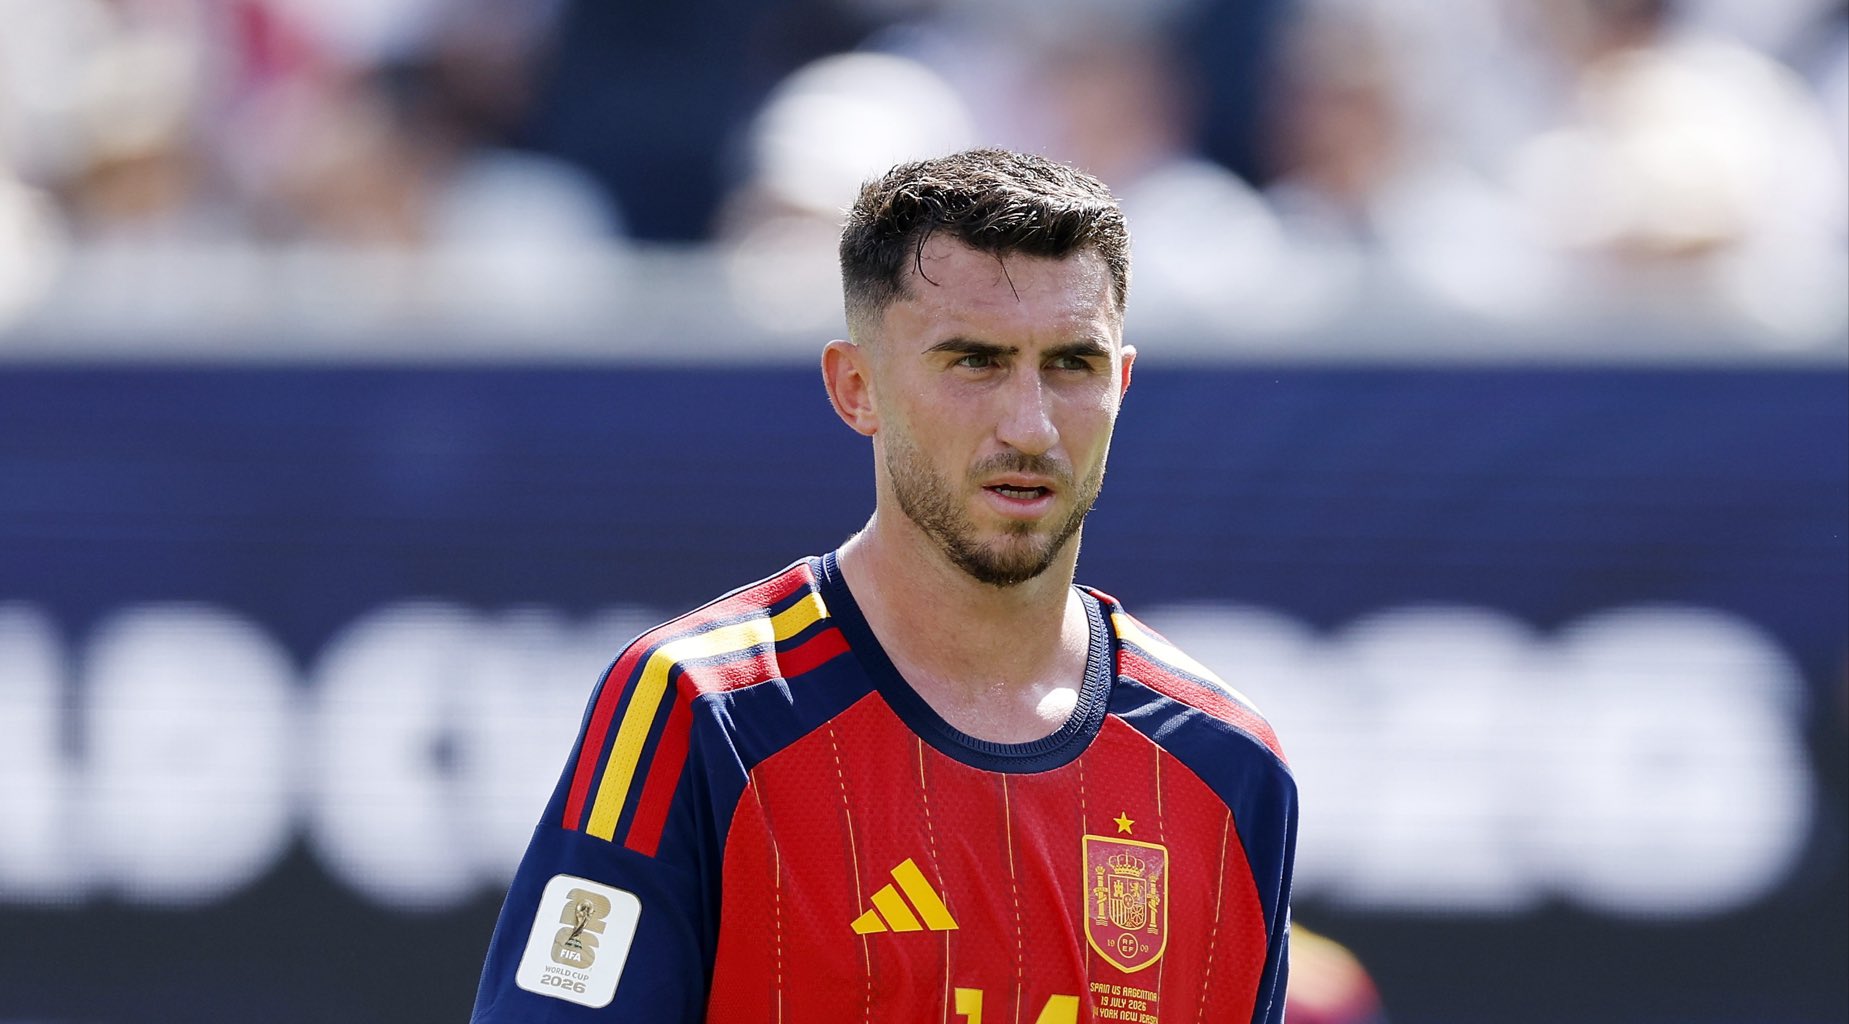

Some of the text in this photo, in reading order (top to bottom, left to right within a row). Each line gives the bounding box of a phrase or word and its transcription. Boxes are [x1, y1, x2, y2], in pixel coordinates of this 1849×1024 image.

[560, 949, 581, 962] FIFA
[545, 965, 590, 981] WORLD CUP
[540, 974, 587, 994] 2026
[1090, 982, 1110, 993] SPAIN
[1123, 987, 1157, 1001] ARGENTINA
[1101, 996, 1146, 1011] 19 JULY 2026
[1100, 1008, 1118, 1019] YORK
[1120, 1011, 1137, 1021] NEW
